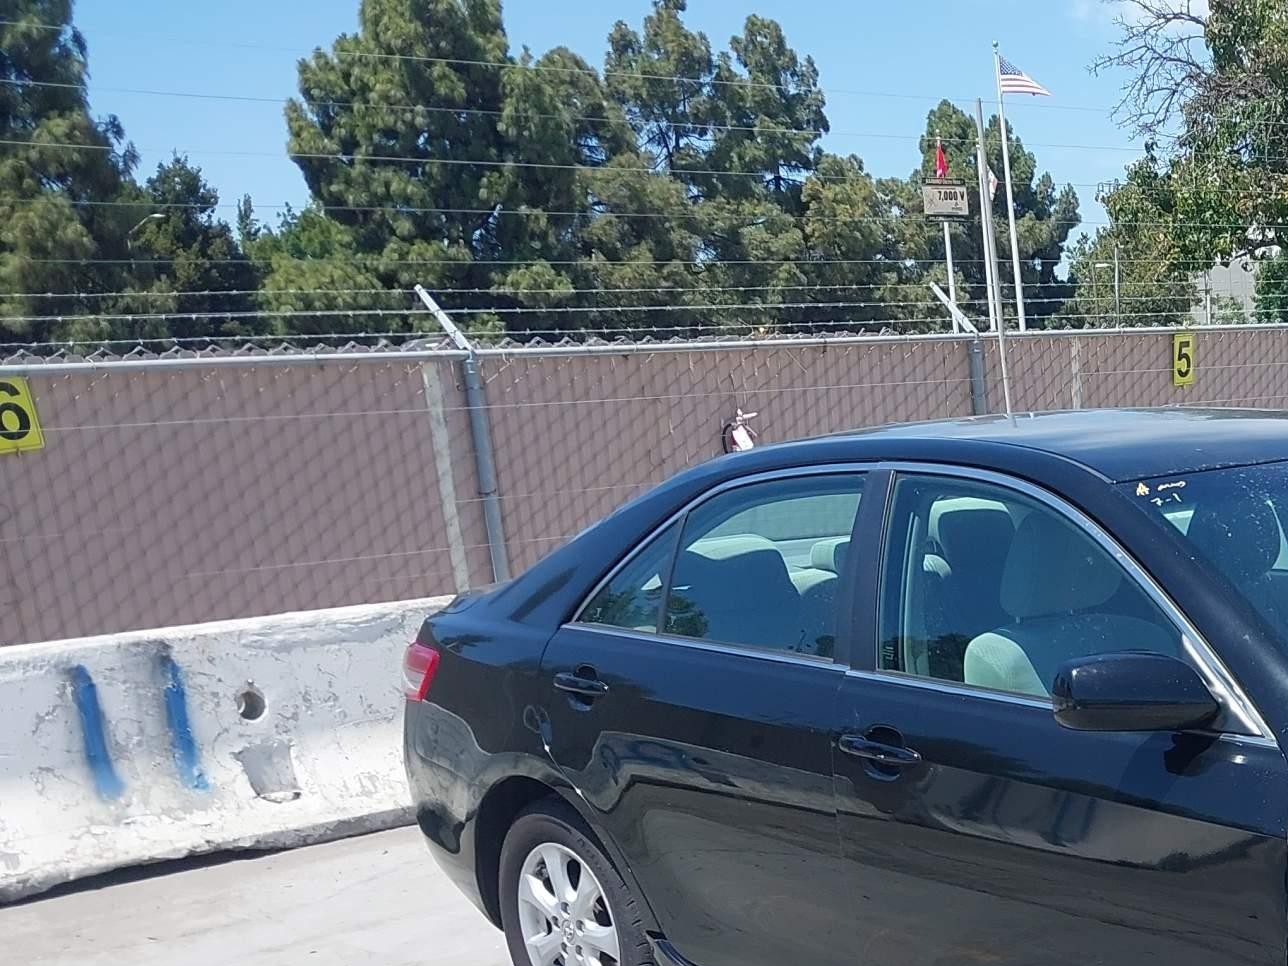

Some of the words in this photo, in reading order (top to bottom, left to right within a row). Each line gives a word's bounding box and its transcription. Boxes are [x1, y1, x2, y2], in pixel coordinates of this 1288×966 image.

[937, 190, 958, 202] 7,000
[959, 190, 965, 201] V
[1176, 340, 1191, 378] 5
[0, 382, 31, 441] 6
